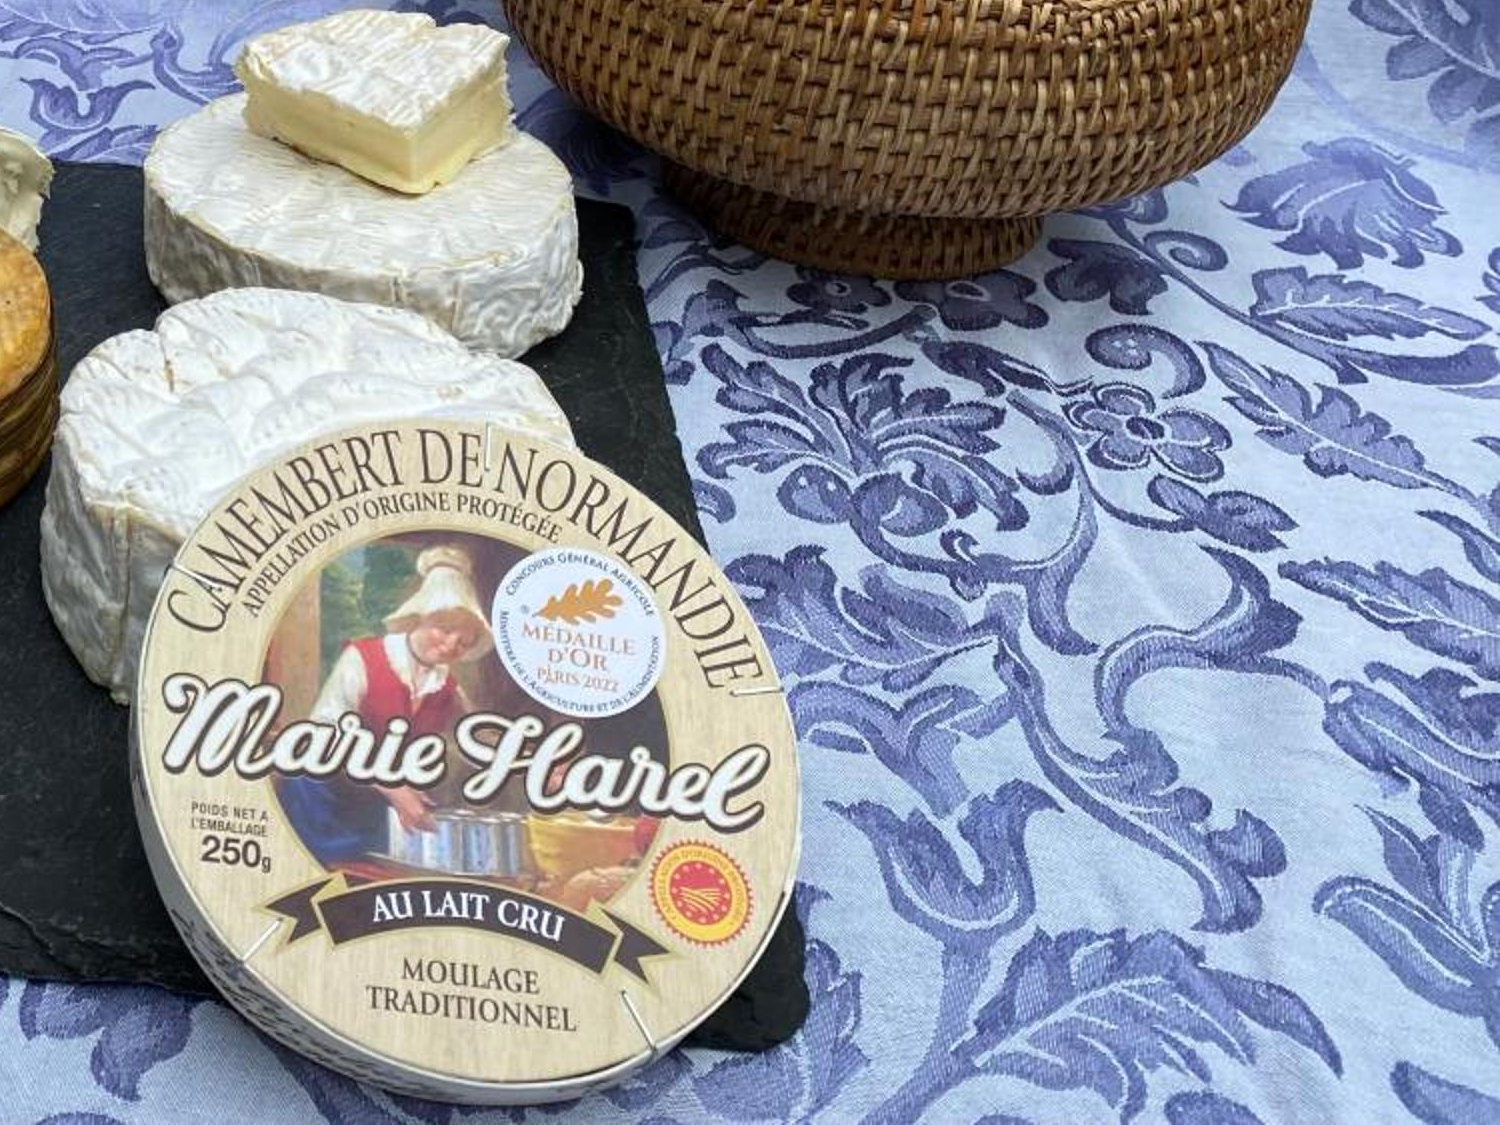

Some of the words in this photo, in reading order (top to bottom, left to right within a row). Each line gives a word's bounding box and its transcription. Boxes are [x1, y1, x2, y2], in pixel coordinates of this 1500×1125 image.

[167, 430, 404, 633] CAMEMBERT
[416, 429, 483, 488] DE
[494, 442, 763, 689] NORMANDIE
[242, 515, 341, 618] APPELLATION
[341, 492, 451, 526] D'ORIGINE
[457, 493, 563, 544] PROTÉGÉE
[506, 554, 555, 596] CONCOURS
[610, 568, 655, 617] AGRICOLE
[537, 666, 580, 686] PARIS
[583, 676, 619, 693] 2022
[548, 647, 608, 671] D'OR
[161, 674, 447, 790] Marie
[454, 711, 772, 834] Harel
[191, 801, 229, 818] POIDS
[233, 806, 256, 820] NET
[191, 818, 269, 837] L'EMBALLAGE
[201, 834, 272, 874] 250g
[373, 894, 414, 923] AU
[421, 890, 491, 921] LAIT
[497, 899, 566, 942] CRU
[402, 956, 541, 996] MOULAGE
[364, 984, 578, 1033] TRADITIONNEL
